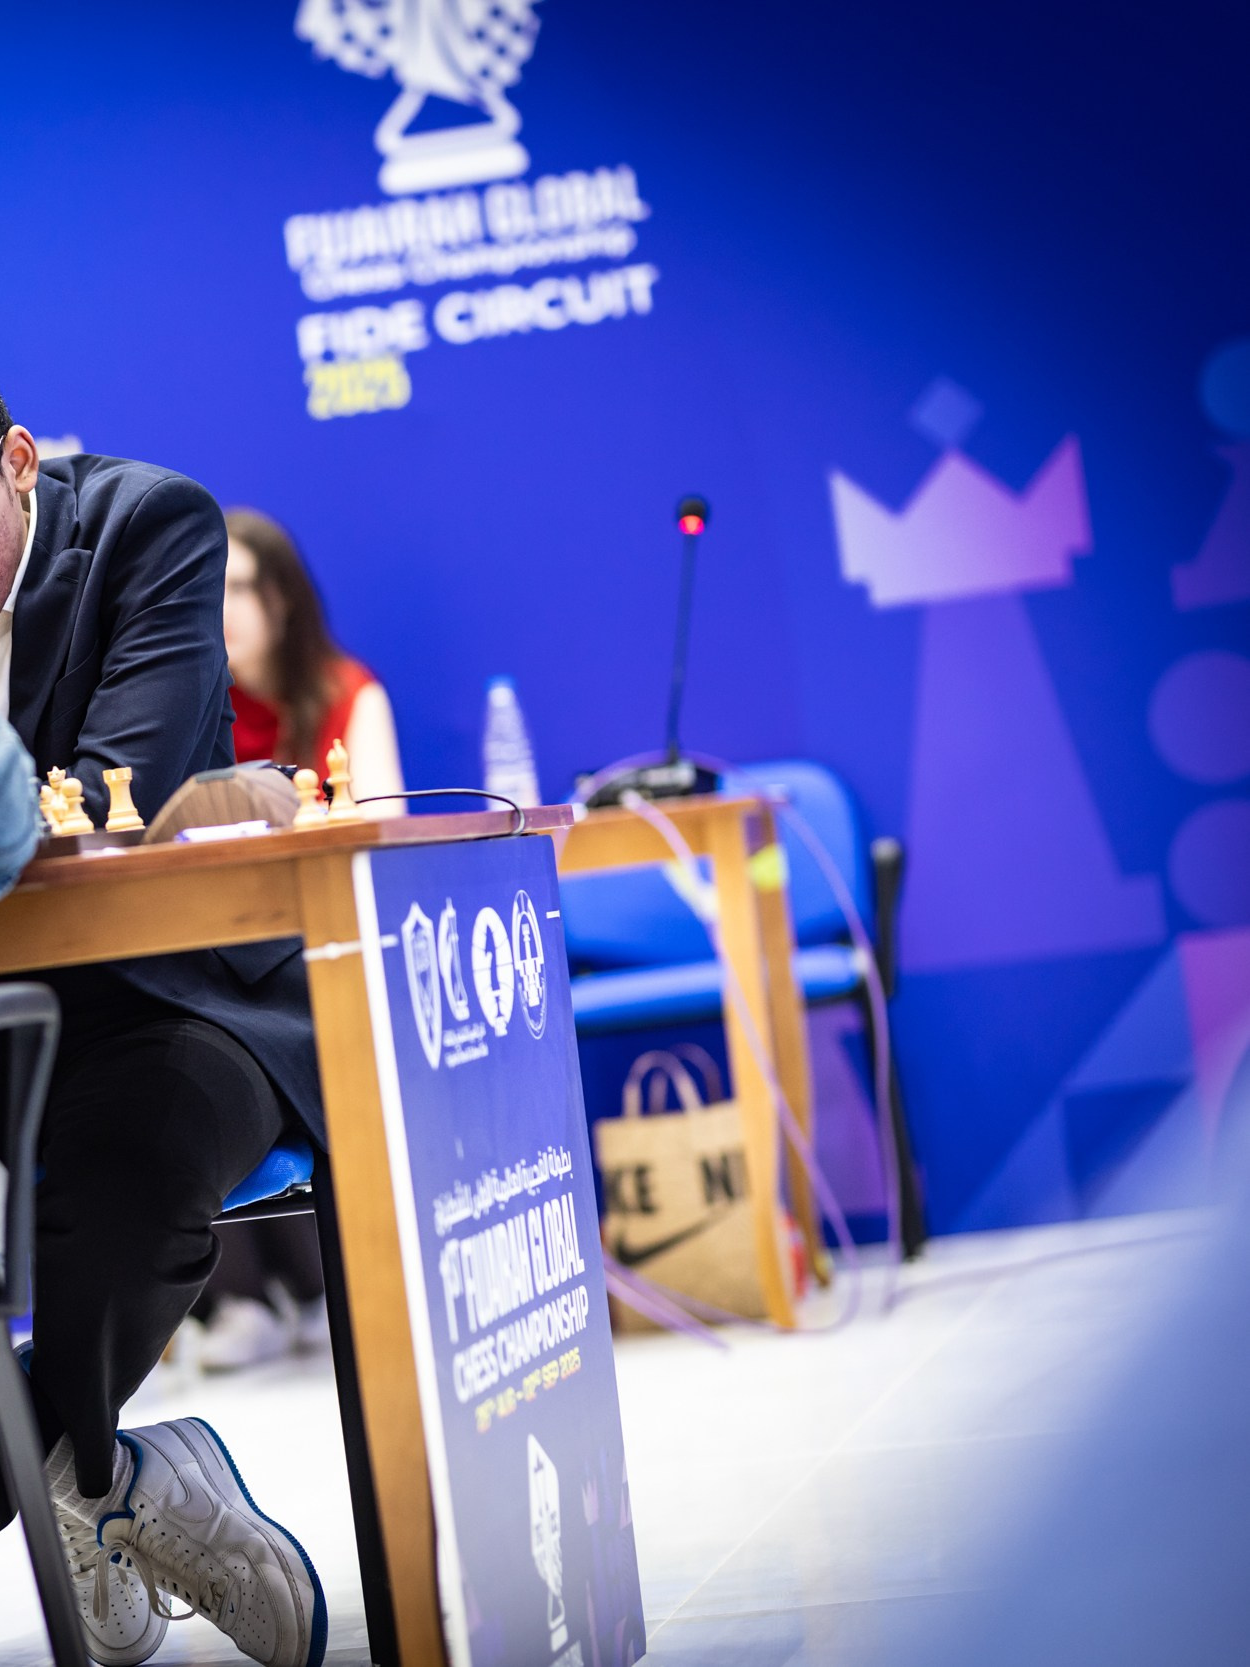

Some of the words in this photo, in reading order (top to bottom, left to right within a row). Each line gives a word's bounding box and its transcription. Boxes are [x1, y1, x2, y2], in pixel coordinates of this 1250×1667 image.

[485, 163, 651, 243] GLOBAL
[297, 298, 429, 361] FIDE
[434, 262, 659, 345] CIRCUIT
[460, 1213, 534, 1334] FUJAIRAH
[527, 1191, 586, 1296] GLOBAL
[453, 1334, 499, 1404] CHESS
[497, 1285, 589, 1377] CHAMPIONSHIP
